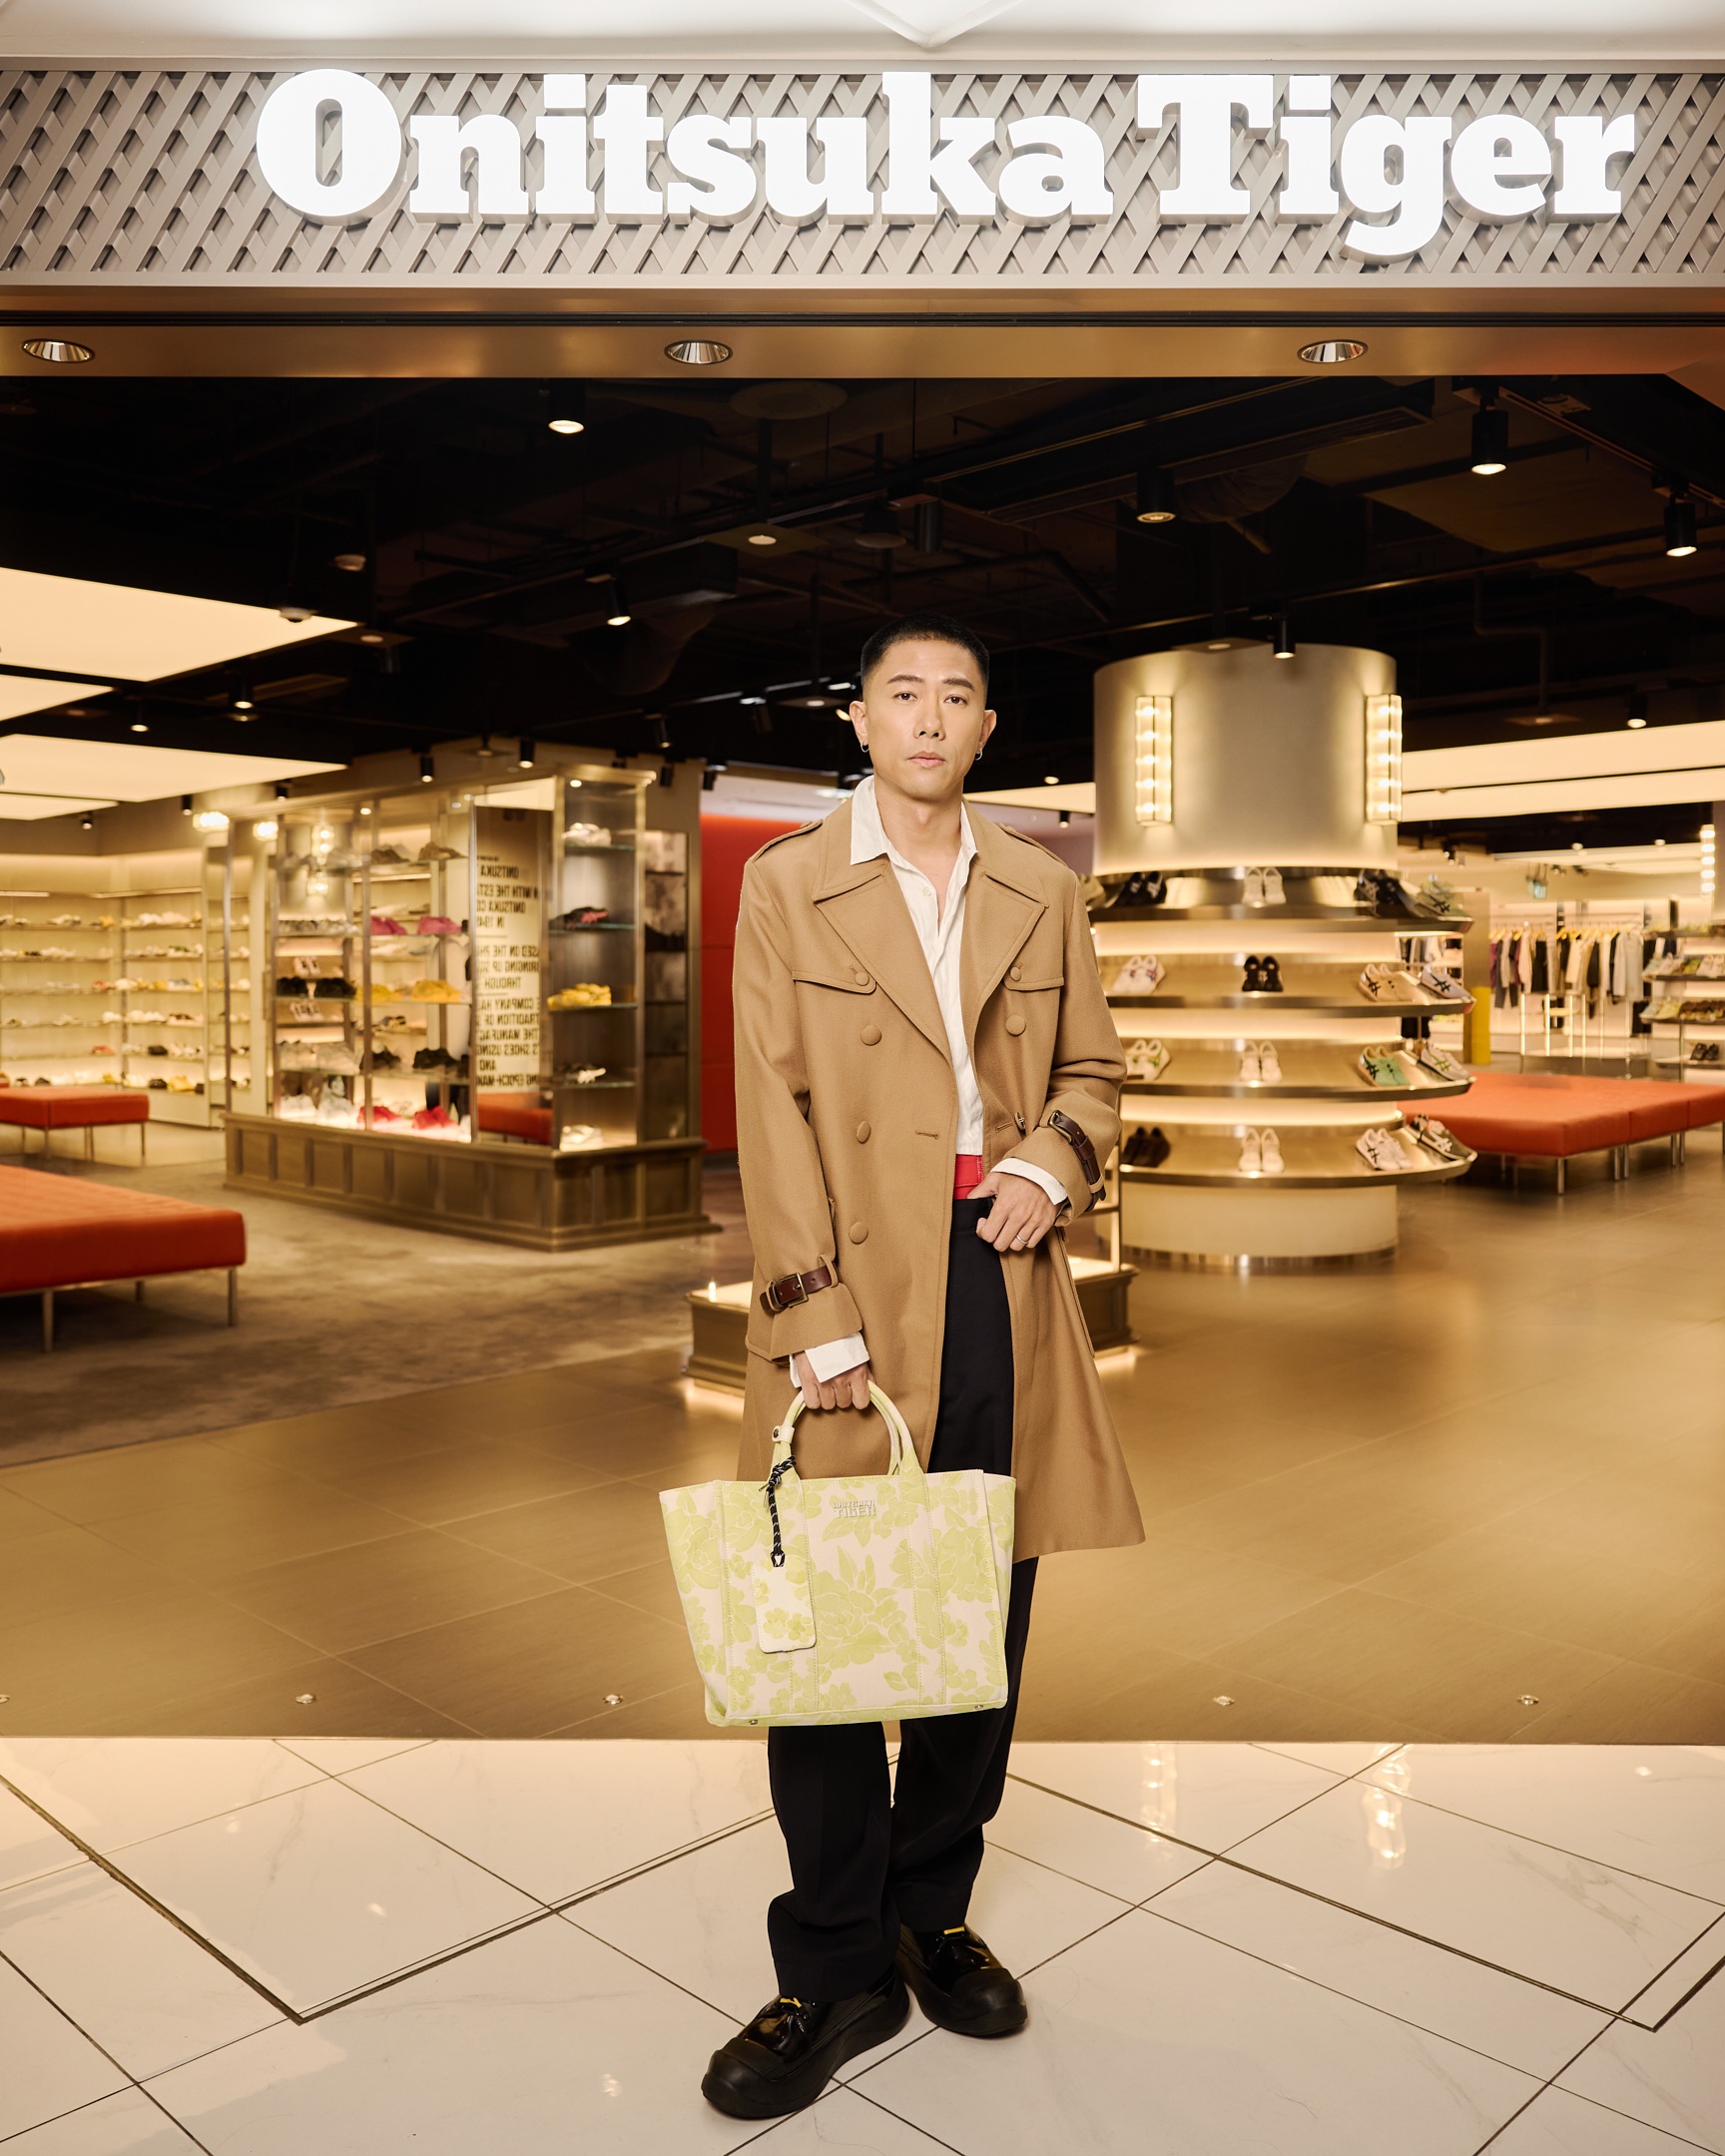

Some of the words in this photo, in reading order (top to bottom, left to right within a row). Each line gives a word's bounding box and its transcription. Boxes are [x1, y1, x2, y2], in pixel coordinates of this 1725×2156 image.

[257, 69, 1114, 223] Onitsuka
[1137, 75, 1635, 259] Tiger
[833, 1506, 876, 1518] TIGER
